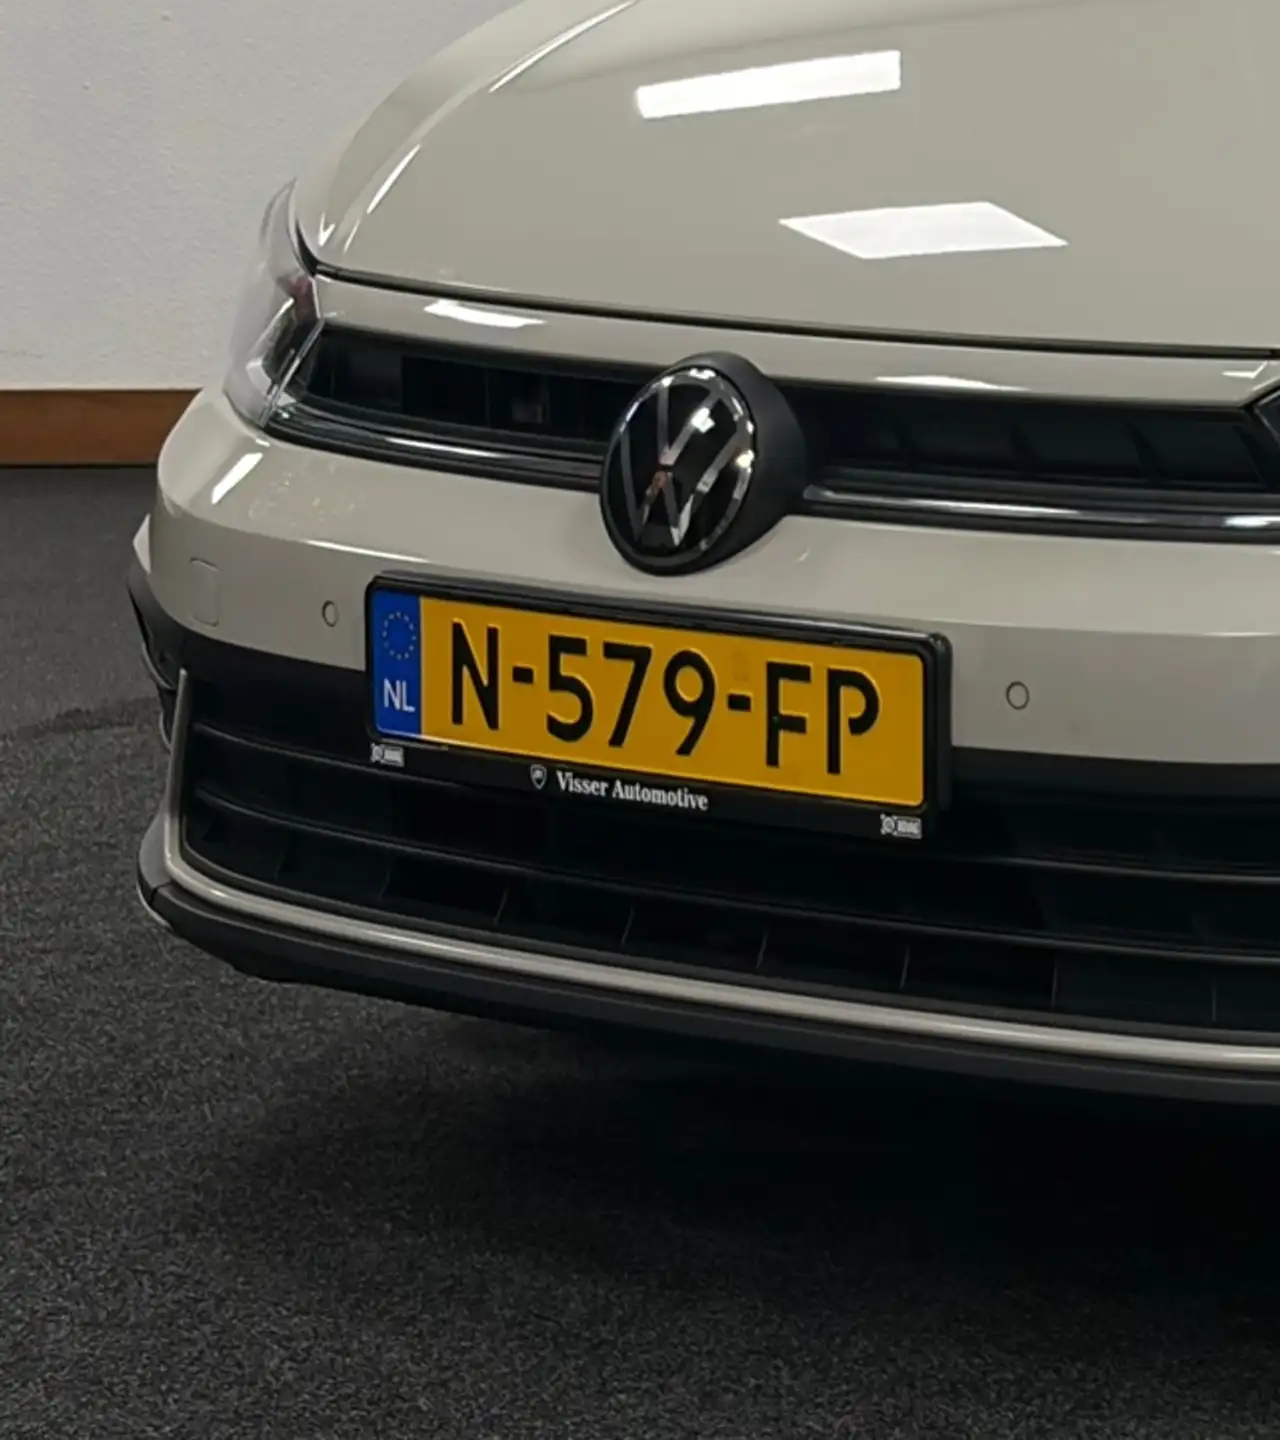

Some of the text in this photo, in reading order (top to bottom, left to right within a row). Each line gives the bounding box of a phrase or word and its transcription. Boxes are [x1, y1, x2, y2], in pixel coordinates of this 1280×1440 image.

[383, 677, 416, 712] NL
[450, 618, 881, 775] N-579-FP
[556, 770, 609, 798] Visser
[612, 779, 709, 810] Automotive
